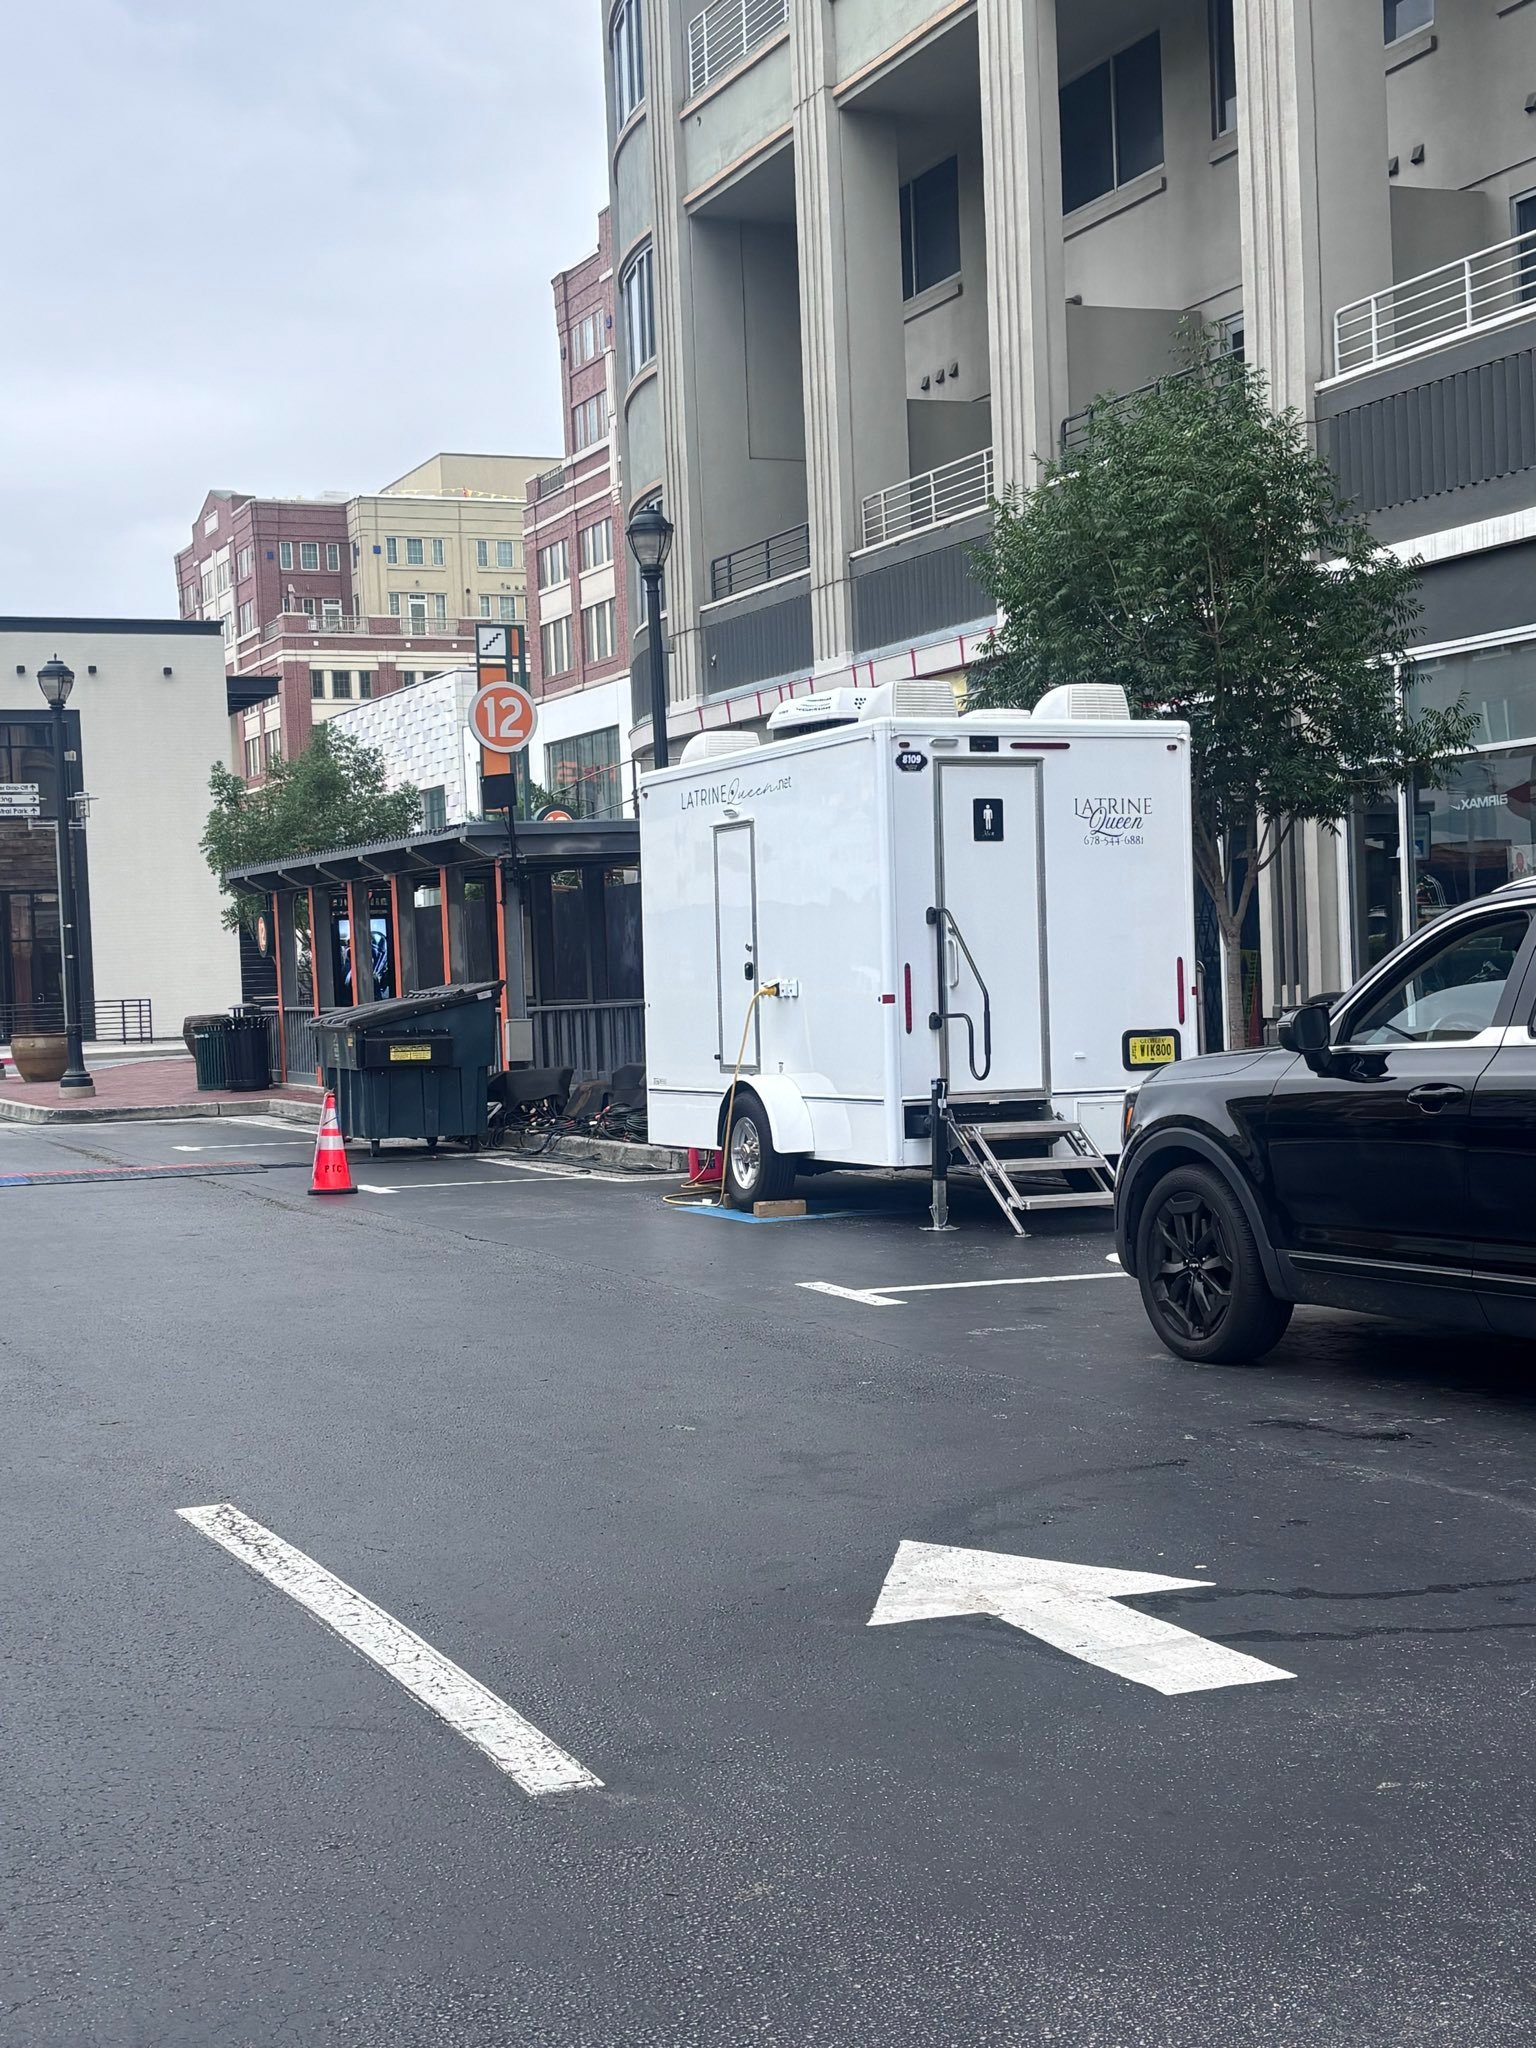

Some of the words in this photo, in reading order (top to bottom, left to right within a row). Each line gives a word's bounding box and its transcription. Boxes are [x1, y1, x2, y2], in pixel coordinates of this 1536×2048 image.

[483, 696, 524, 738] 12
[902, 754, 922, 764] 8109
[1074, 797, 1153, 819] LATRINE
[1089, 806, 1144, 837] Queen
[1083, 835, 1145, 846] 678-544-6881
